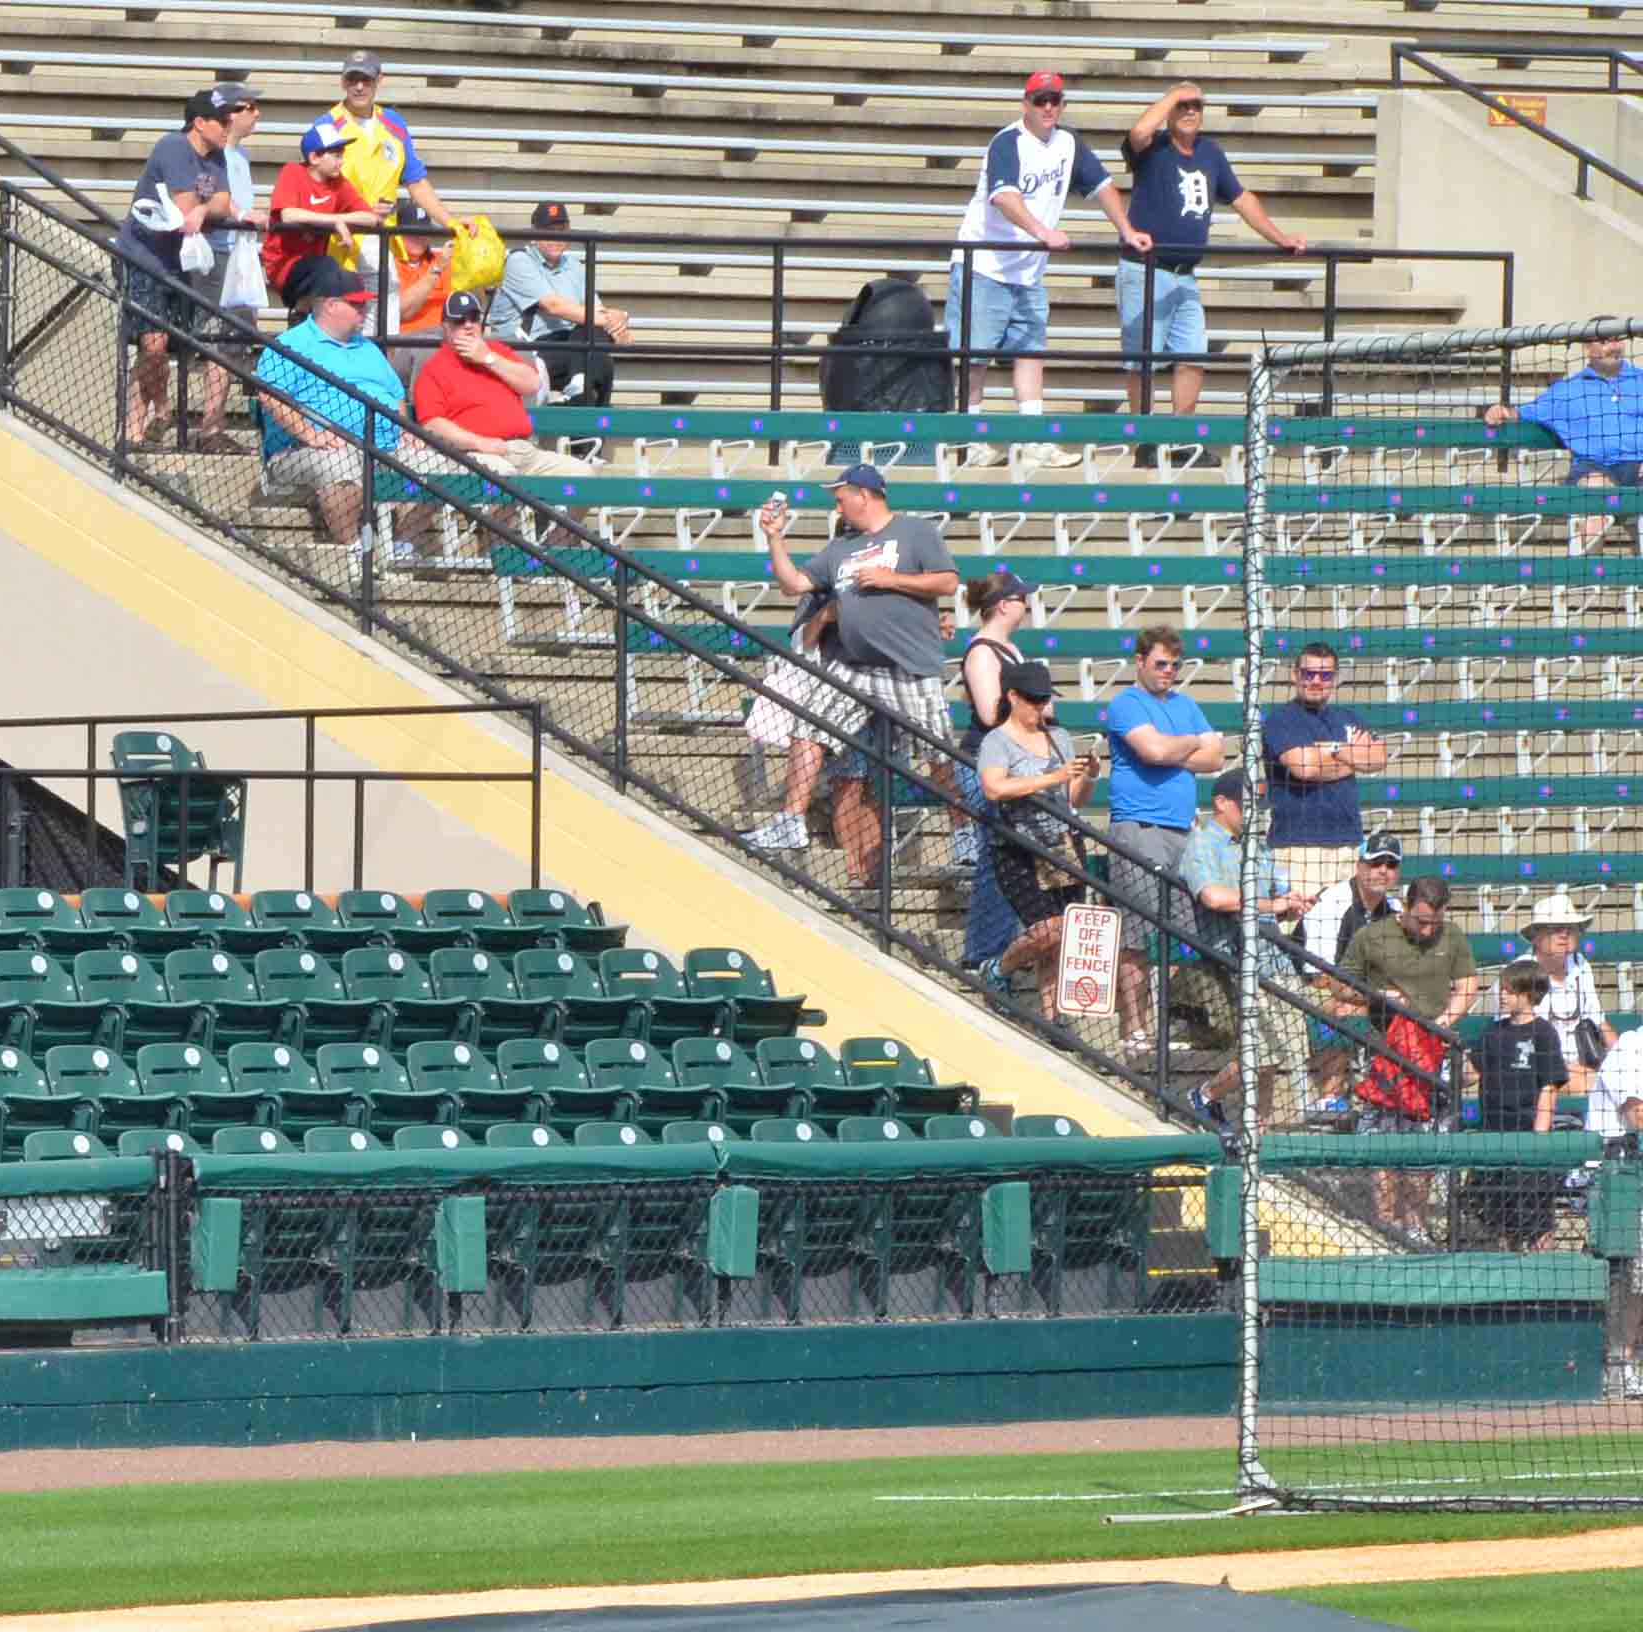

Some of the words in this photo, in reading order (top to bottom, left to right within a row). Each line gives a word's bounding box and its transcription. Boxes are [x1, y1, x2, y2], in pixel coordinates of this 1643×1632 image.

[1075, 912, 1110, 926] KEEP
[1079, 928, 1103, 940] OFF
[1079, 943, 1103, 956] THE
[1067, 957, 1111, 973] FENCE
